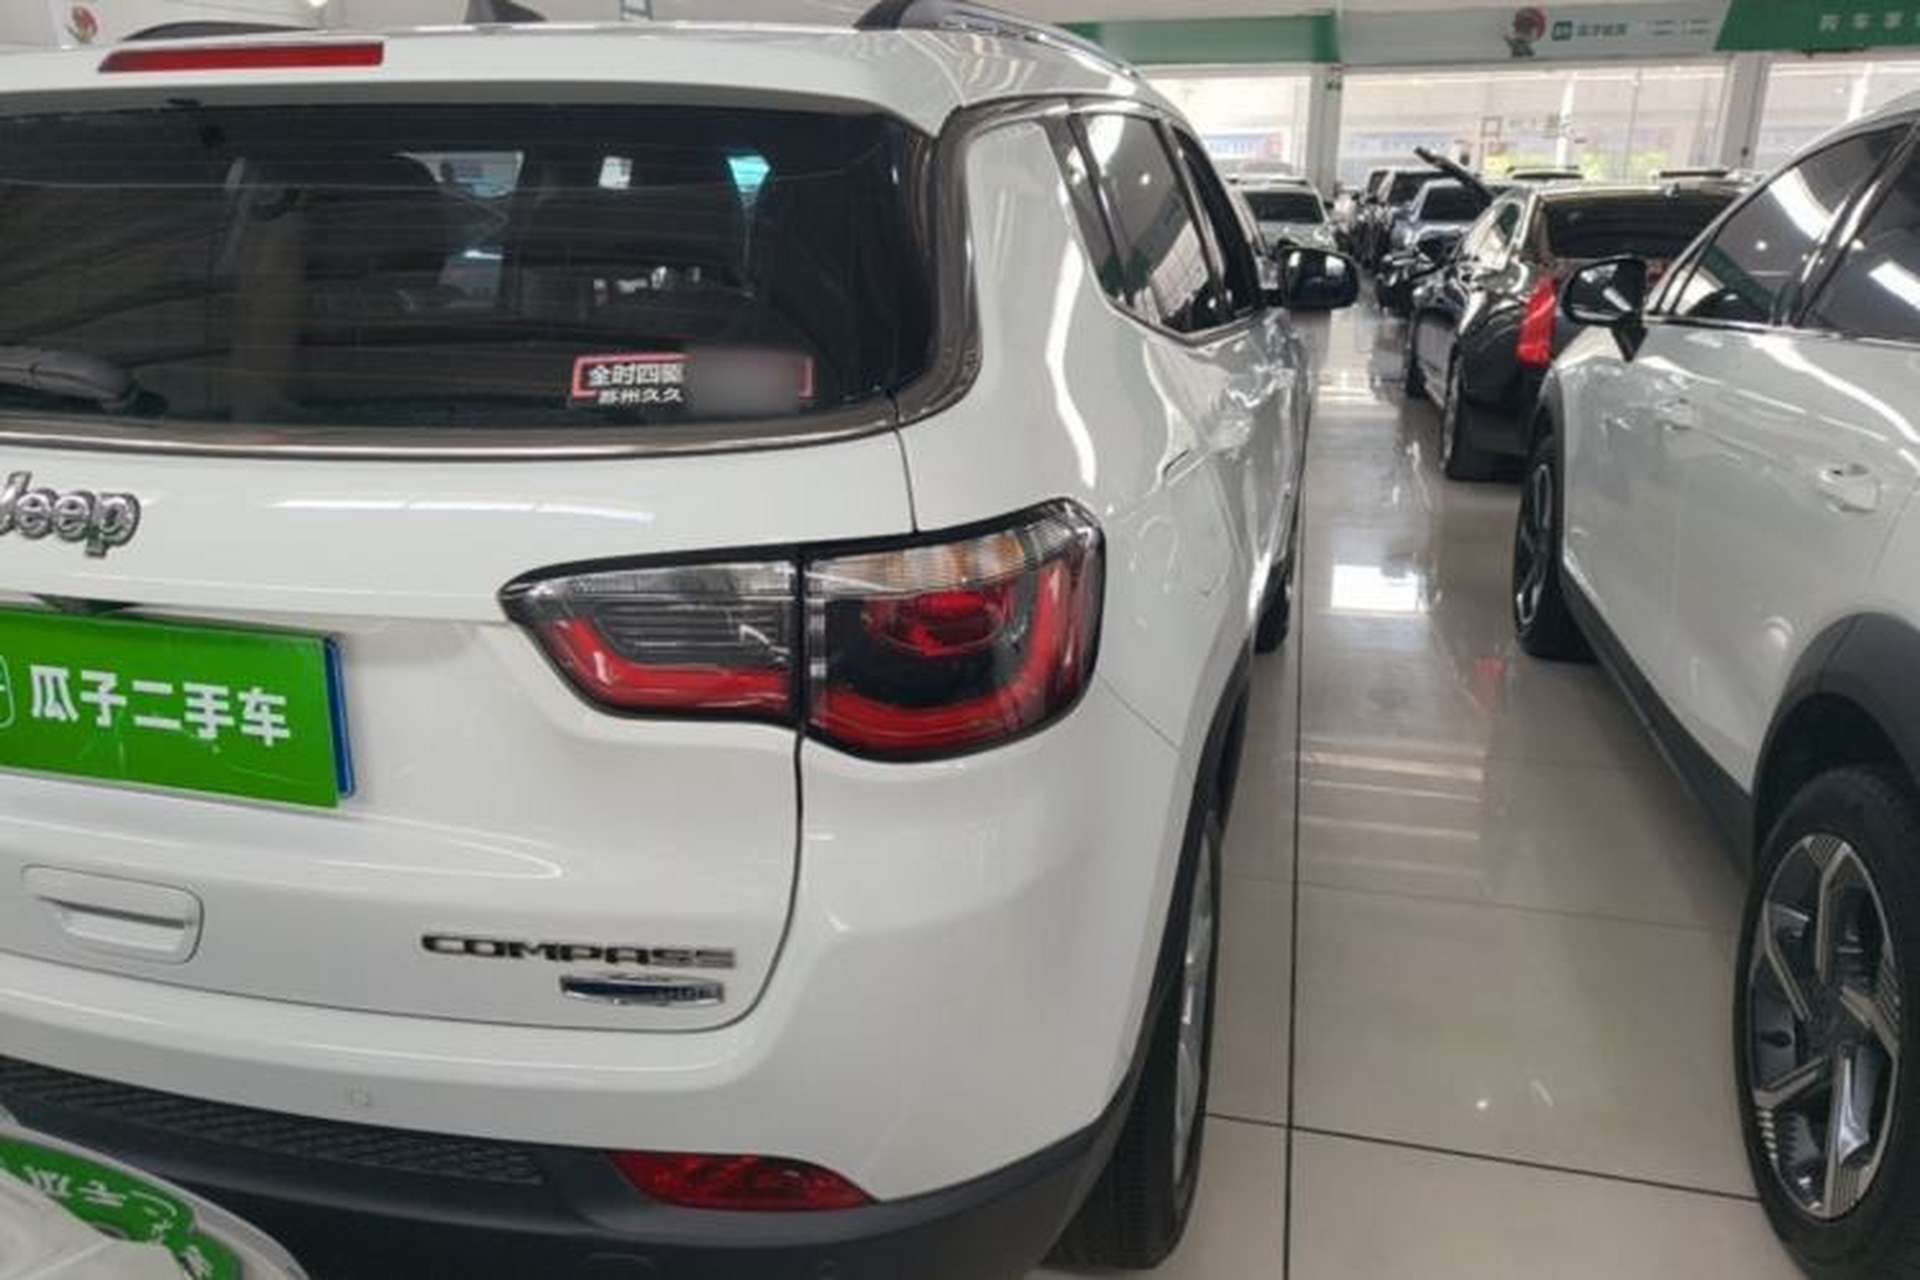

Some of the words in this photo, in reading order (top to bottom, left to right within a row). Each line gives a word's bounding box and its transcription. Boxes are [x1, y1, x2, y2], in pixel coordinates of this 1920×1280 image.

[30, 664, 291, 747] 瓜子二手车
[421, 934, 736, 969] COMPASS
